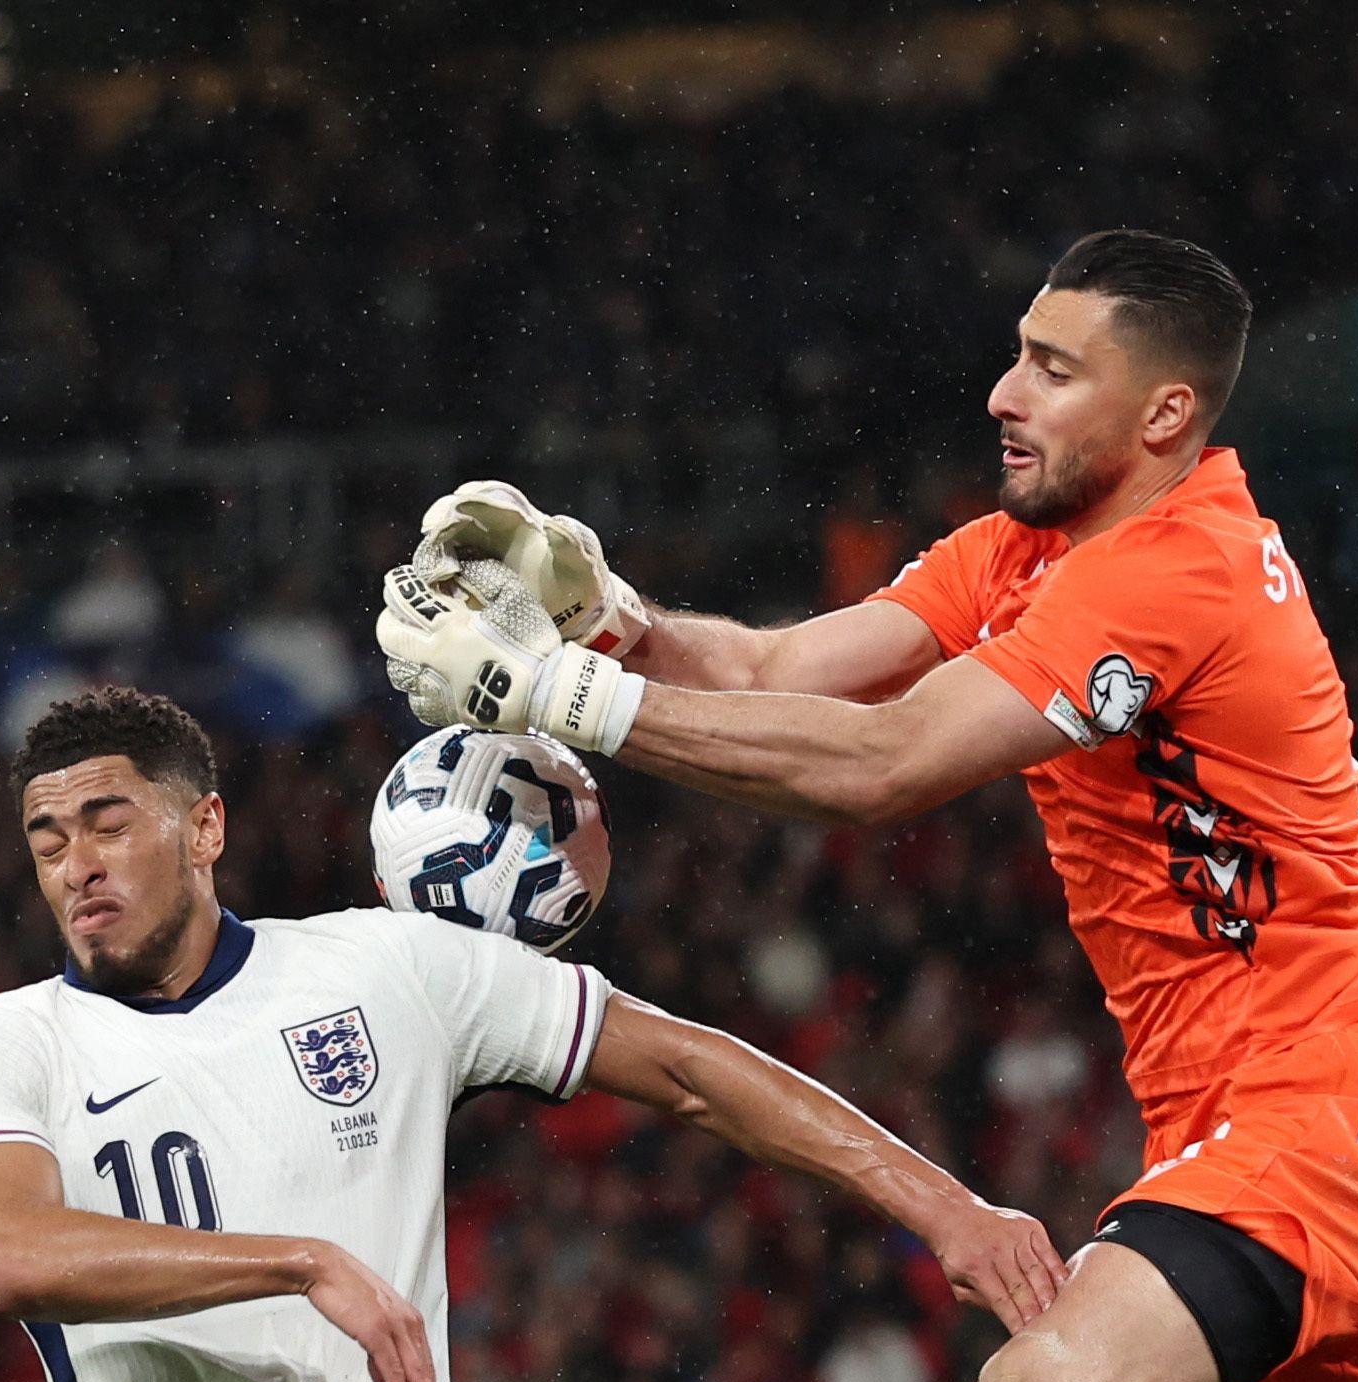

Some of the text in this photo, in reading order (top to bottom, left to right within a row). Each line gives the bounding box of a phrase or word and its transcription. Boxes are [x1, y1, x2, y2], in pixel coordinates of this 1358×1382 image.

[331, 1111, 378, 1134] ALBANIA
[337, 1130, 378, 1152] 21.03.25
[93, 1131, 223, 1233] 10
